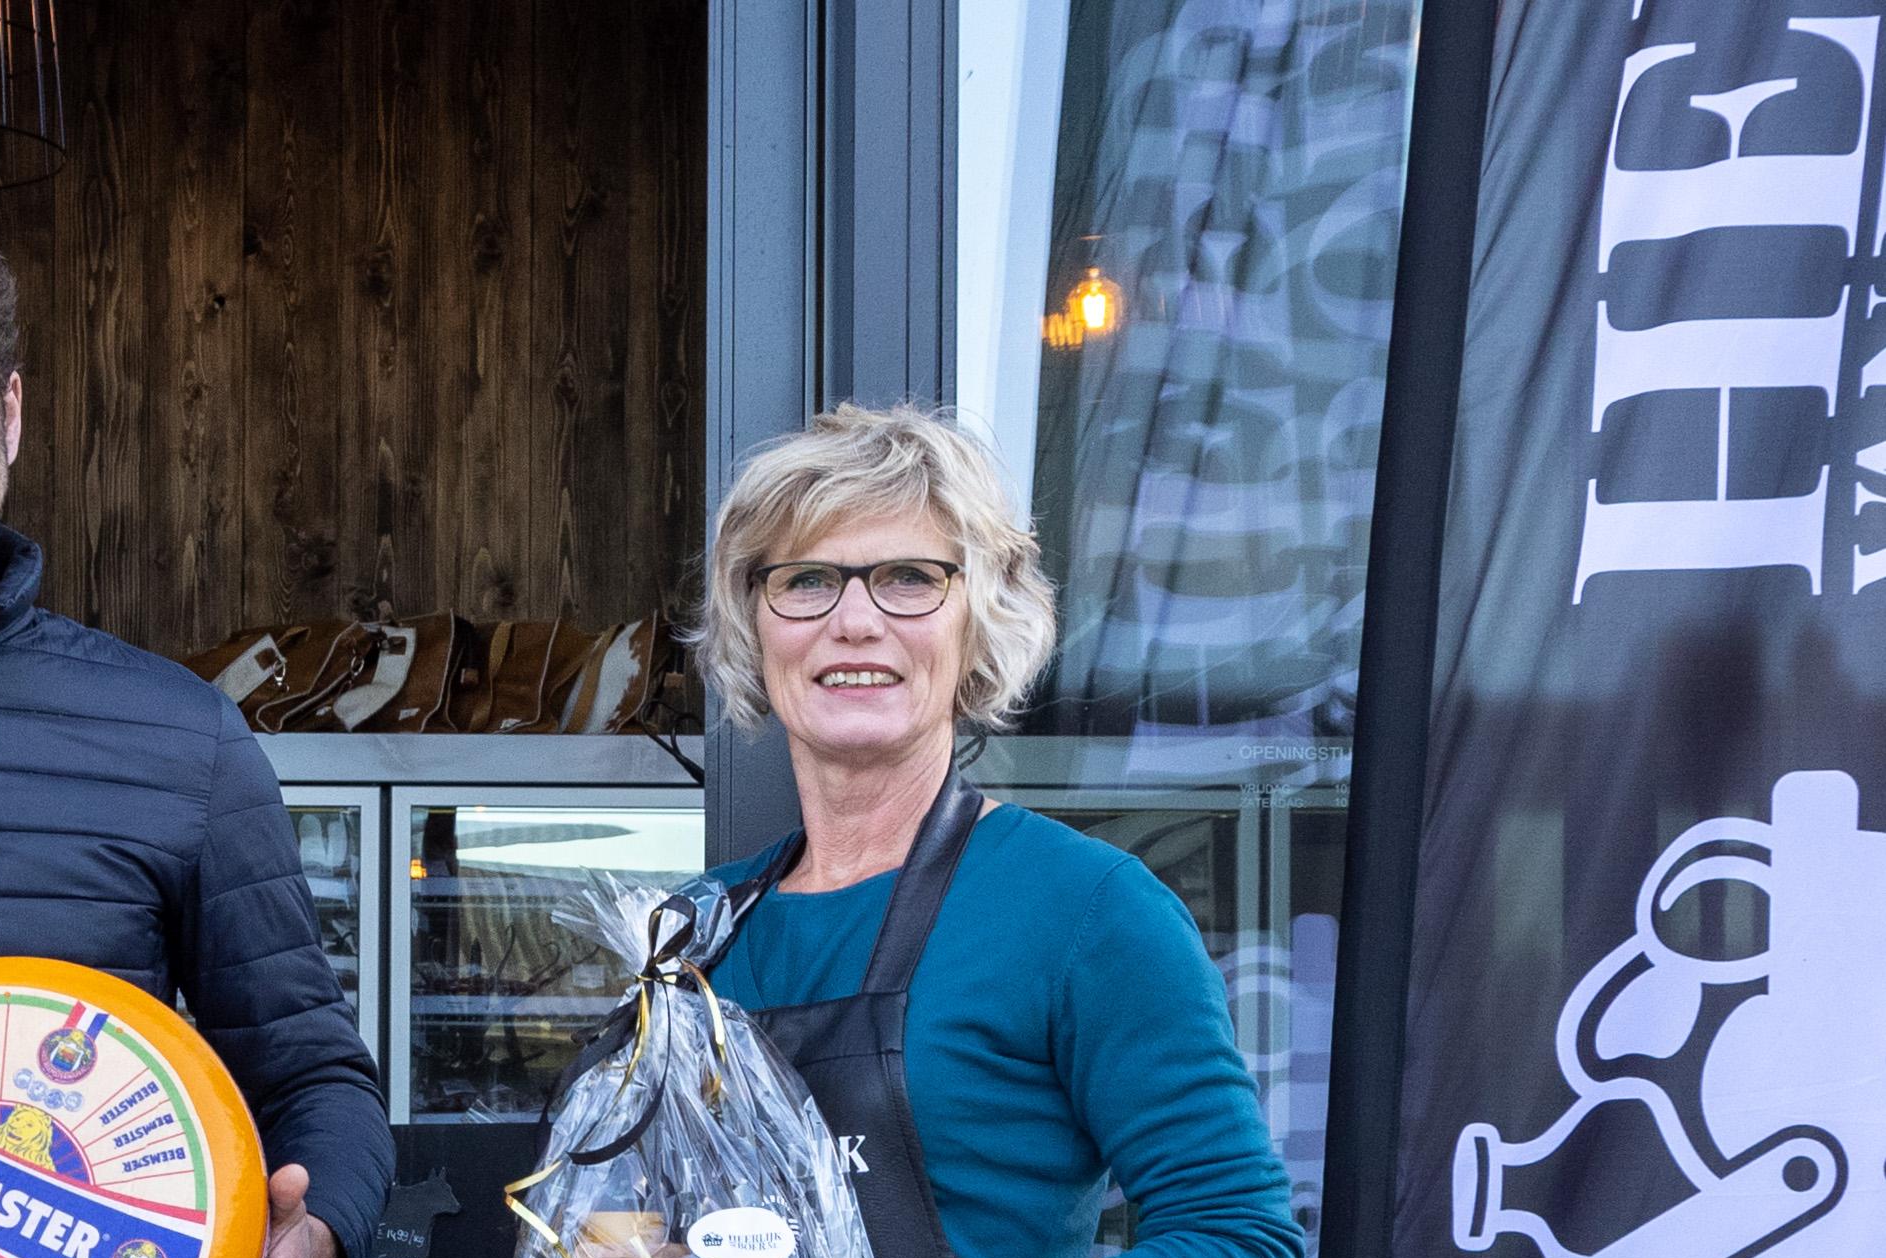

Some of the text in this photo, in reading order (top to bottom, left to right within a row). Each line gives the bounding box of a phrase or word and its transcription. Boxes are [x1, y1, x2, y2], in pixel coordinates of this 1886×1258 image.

[1573, 0, 1881, 604] HE
[100, 1081, 160, 1126] BEEMSTER
[114, 1113, 174, 1147] BEEMSTER
[122, 1147, 185, 1173] BEEMSTER
